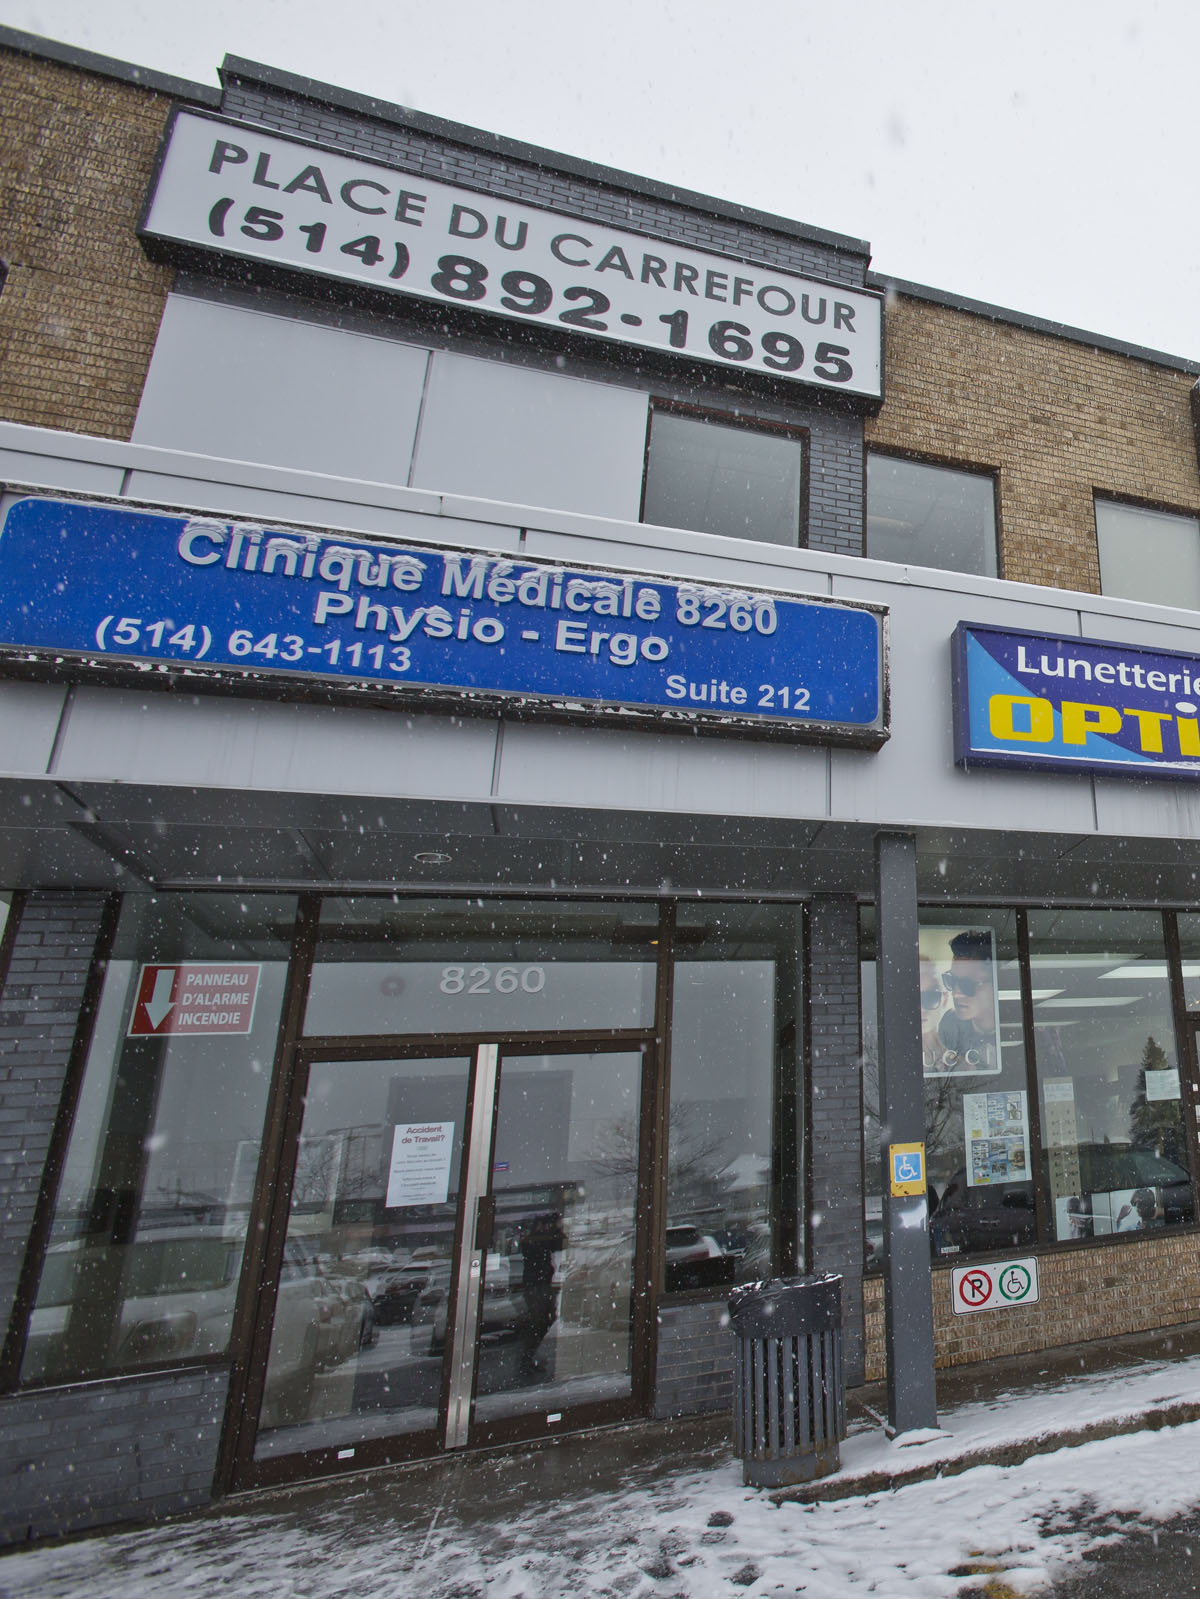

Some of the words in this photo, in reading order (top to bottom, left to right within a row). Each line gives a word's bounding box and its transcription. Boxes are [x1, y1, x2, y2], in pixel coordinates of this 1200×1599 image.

[208, 139, 427, 227] PLACE
[449, 203, 528, 251] DU
[550, 231, 859, 334] CARREFOUR
[208, 197, 411, 280] (514)
[430, 253, 855, 384] 892-1695
[178, 524, 424, 593] Clinique
[676, 588, 778, 635] 8260
[314, 591, 505, 643] Physio
[556, 619, 670, 666] Ergo
[95, 616, 212, 659] (514)
[228, 629, 412, 672] 643-1113
[666, 675, 748, 705] Suite
[757, 685, 811, 713] 212
[185, 973, 249, 987] PANNEAU
[439, 966, 546, 995] 8260
[182, 992, 250, 1006] D'ALARME
[178, 1012, 241, 1025] INCENDIE
[922, 1044, 990, 1068] UCCI
[406, 1125, 443, 1135] Accident
[414, 1134, 446, 1144] Travail?
